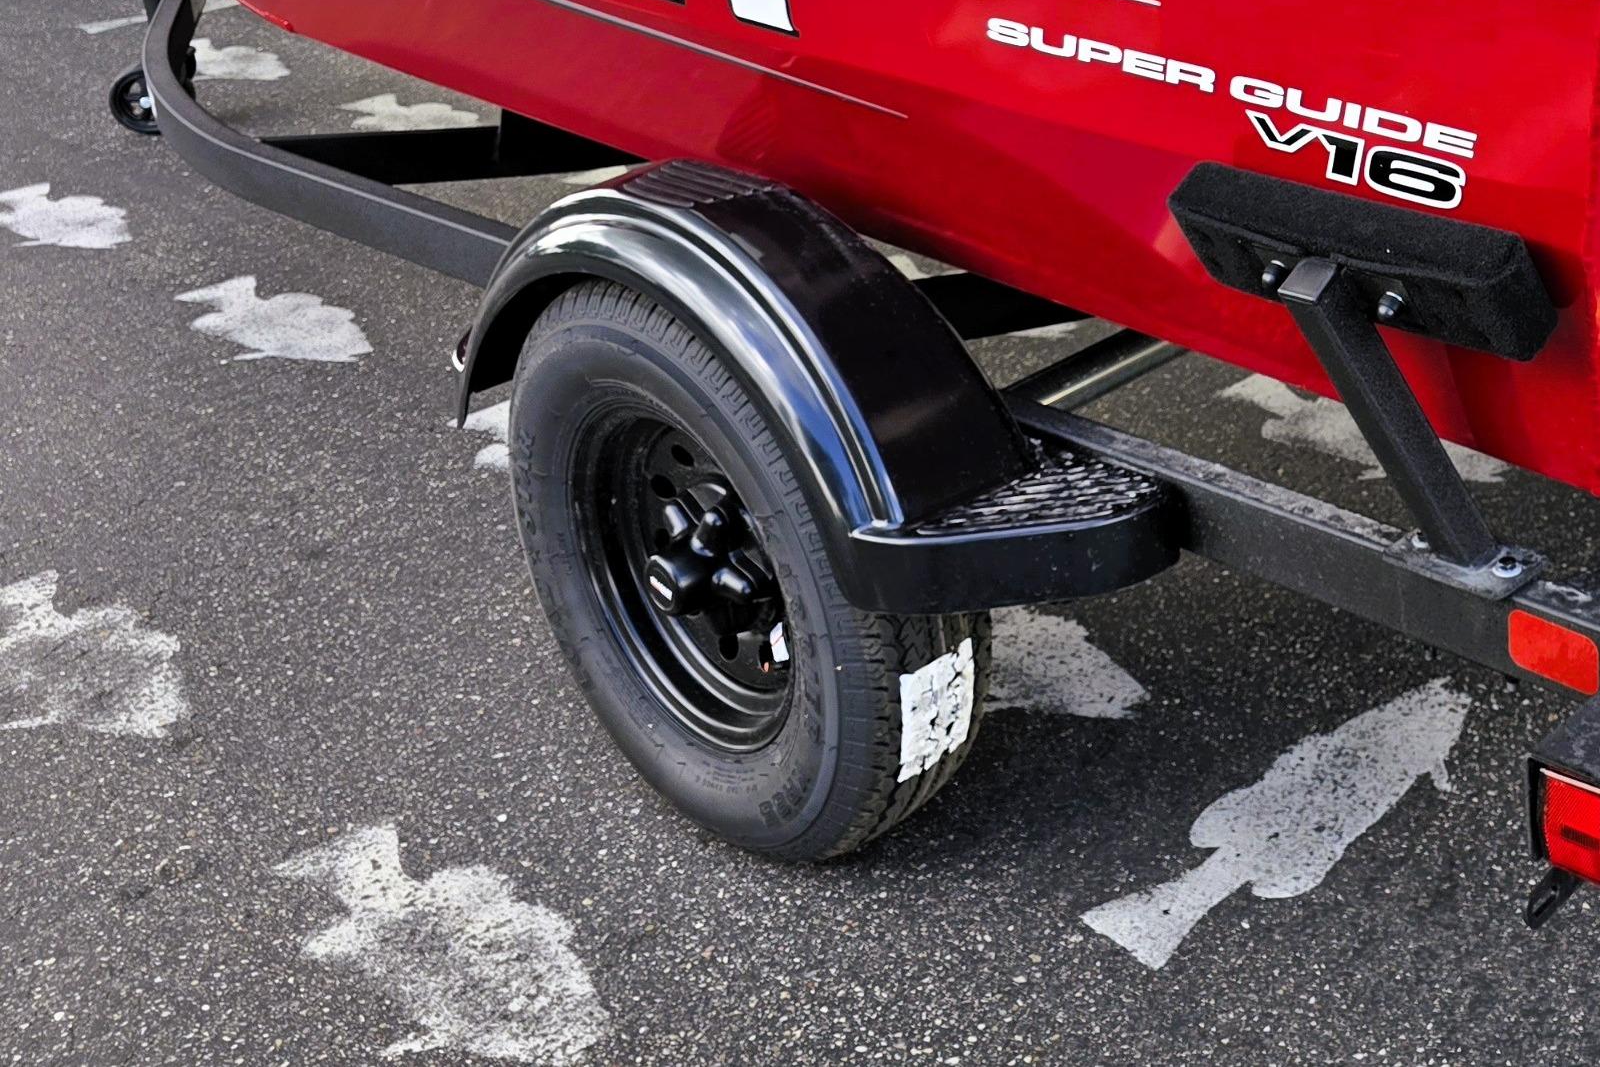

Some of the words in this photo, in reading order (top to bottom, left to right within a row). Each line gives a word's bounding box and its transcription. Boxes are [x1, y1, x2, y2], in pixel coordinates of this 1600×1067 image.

[986, 17, 1215, 94] SUPER
[1229, 75, 1477, 159] GUIDE
[1245, 108, 1468, 210] V16
